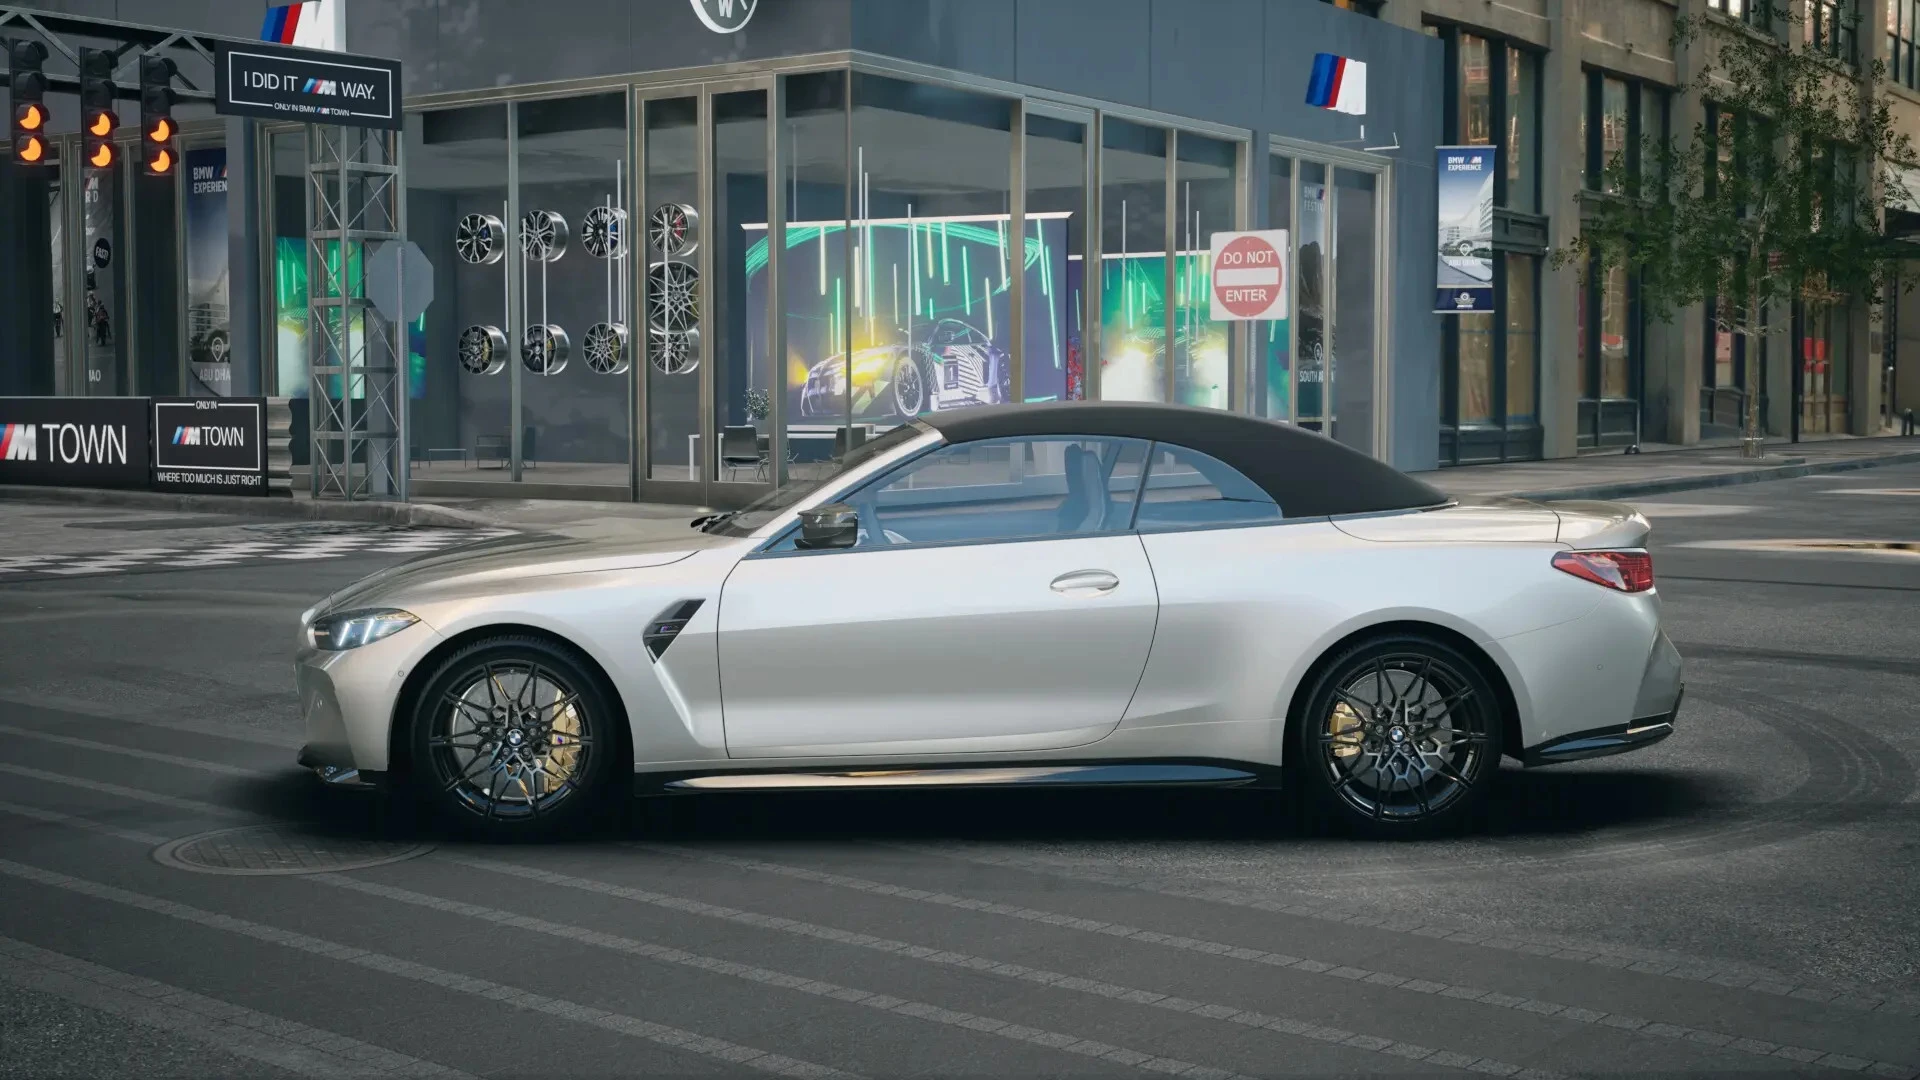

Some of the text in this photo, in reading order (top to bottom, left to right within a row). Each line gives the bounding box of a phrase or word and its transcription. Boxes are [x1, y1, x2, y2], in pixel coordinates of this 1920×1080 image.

[244, 70, 248, 87] I
[252, 72, 280, 90] DID
[283, 75, 299, 92] IT
[341, 81, 376, 100] WAY.
[274, 102, 291, 111] ONLY
[291, 104, 299, 112] IN
[299, 104, 316, 113] BMW
[331, 108, 350, 117] TOWN
[1447, 156, 1465, 164] BMW
[193, 166, 214, 180] BMW
[1223, 250, 1274, 265] DO NOT
[1225, 288, 1268, 303] ENTER
[200, 367, 213, 382] ABU
[1299, 370, 1318, 383] SOUTH
[195, 400, 217, 410] ONLY IN
[42, 423, 127, 464] TOWN
[201, 426, 244, 447] TOWN
[157, 472, 262, 486] WHERE TOO MUCH IS JUST RIGHT
